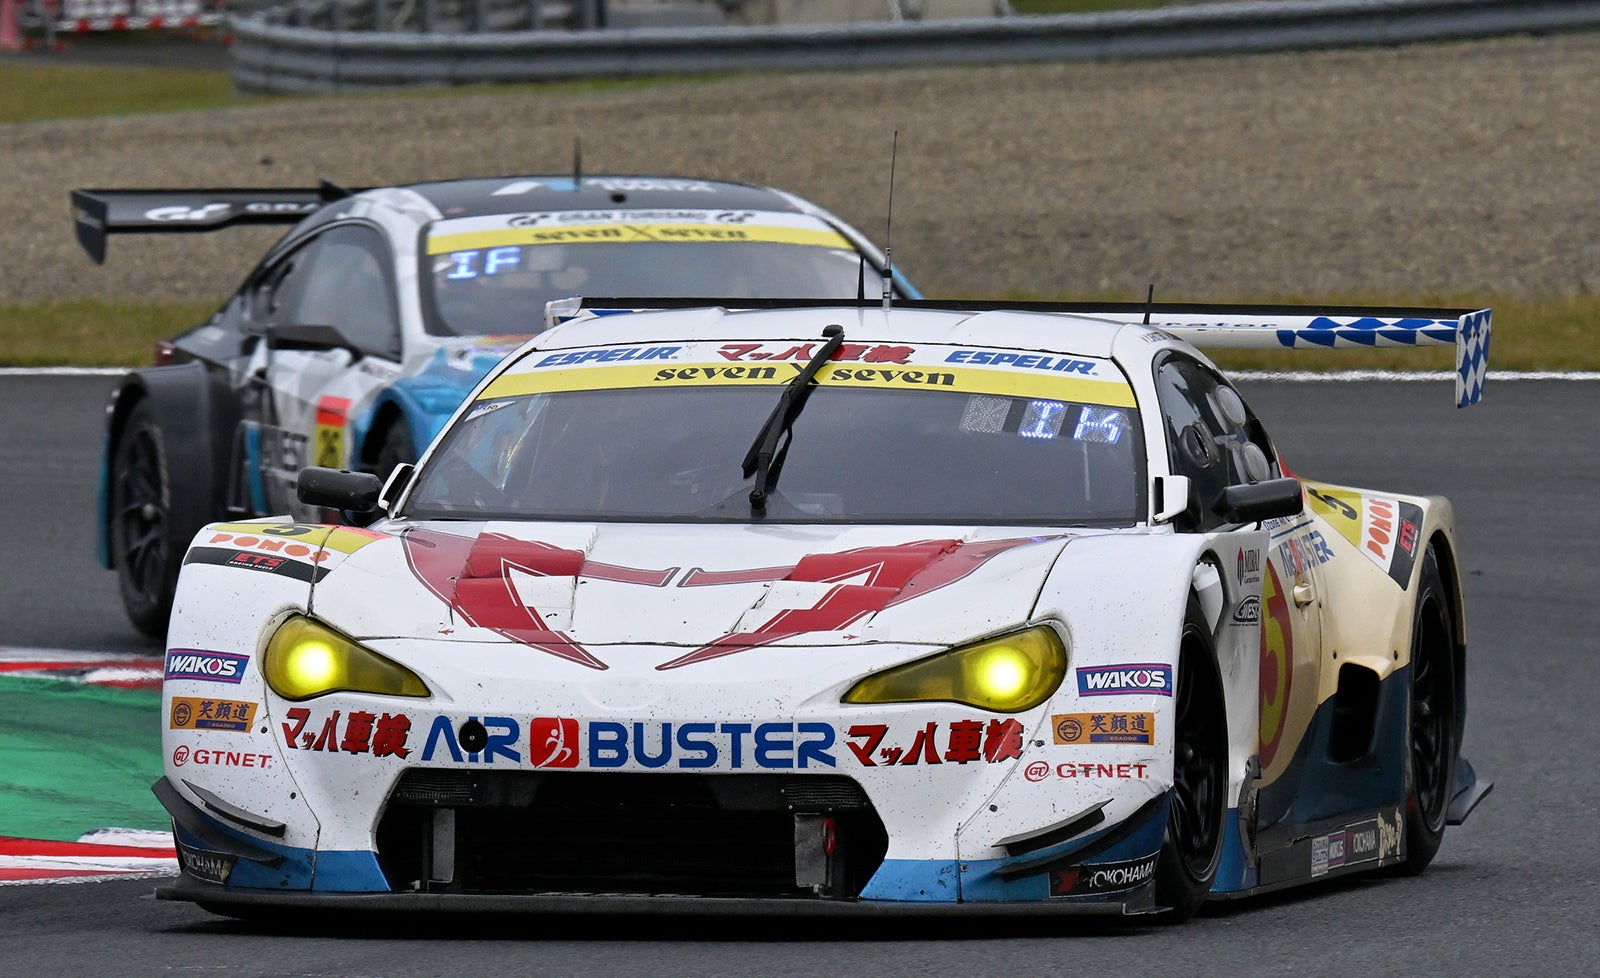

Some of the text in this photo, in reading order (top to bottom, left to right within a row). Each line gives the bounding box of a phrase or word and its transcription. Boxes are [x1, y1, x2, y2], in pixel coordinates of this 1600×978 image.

[533, 346, 682, 368] ESPELIR
[944, 350, 1096, 376] ESPELIR
[653, 366, 778, 382] seven
[830, 366, 956, 387] seven
[262, 524, 326, 537] 5
[1366, 499, 1393, 561] PONOS
[209, 533, 331, 563] PONOS
[234, 552, 286, 567] ETS
[198, 700, 250, 721] 笑顔道
[281, 707, 413, 760] マッハ車検
[1090, 714, 1150, 734] 笑顔道
[589, 721, 837, 769] BUSTER
[846, 718, 1026, 768] マッハ車検
[193, 750, 272, 768] GTNET
[1056, 763, 1148, 779] GTNET
